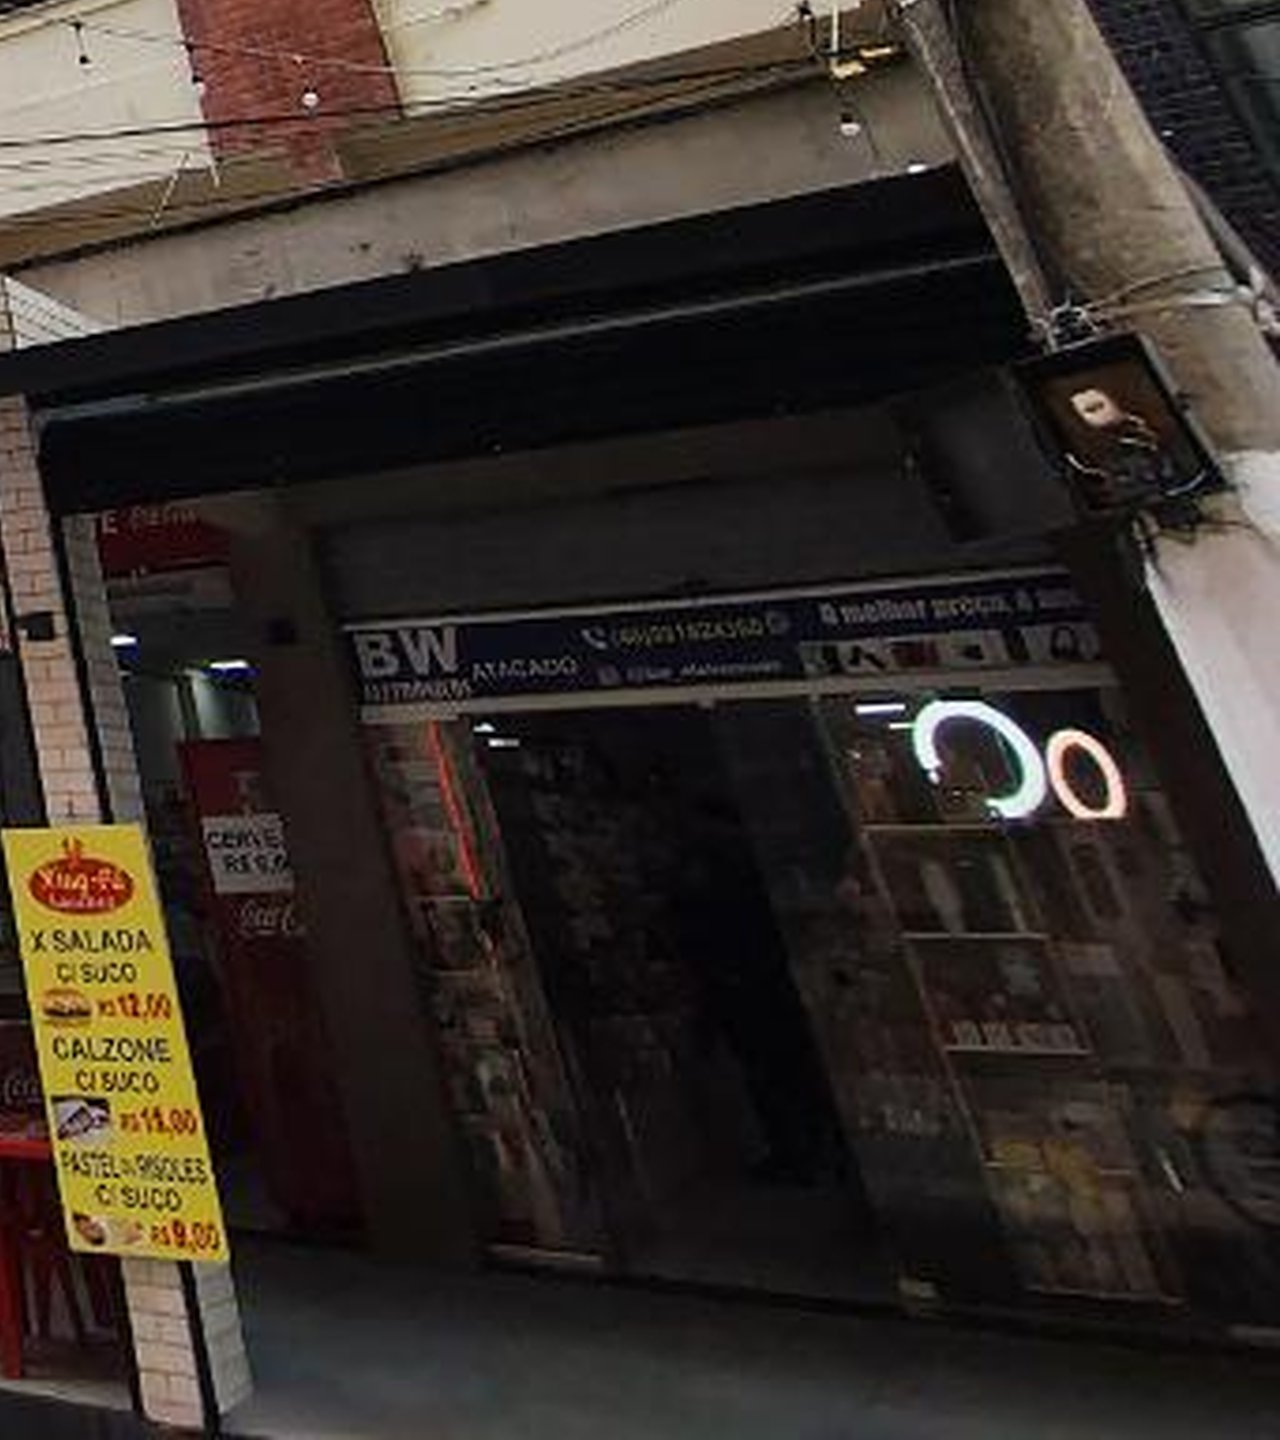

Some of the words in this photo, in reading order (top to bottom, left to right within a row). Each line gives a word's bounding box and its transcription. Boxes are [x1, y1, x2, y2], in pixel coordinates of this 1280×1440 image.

[353, 626, 459, 678] BW
[31, 930, 47, 953] X
[52, 928, 153, 954] SALADA
[79, 962, 138, 983] SUCO
[52, 1036, 171, 1063] CALZONE
[102, 1071, 160, 1094] SUCO
[120, 1185, 183, 1211] SUCO
